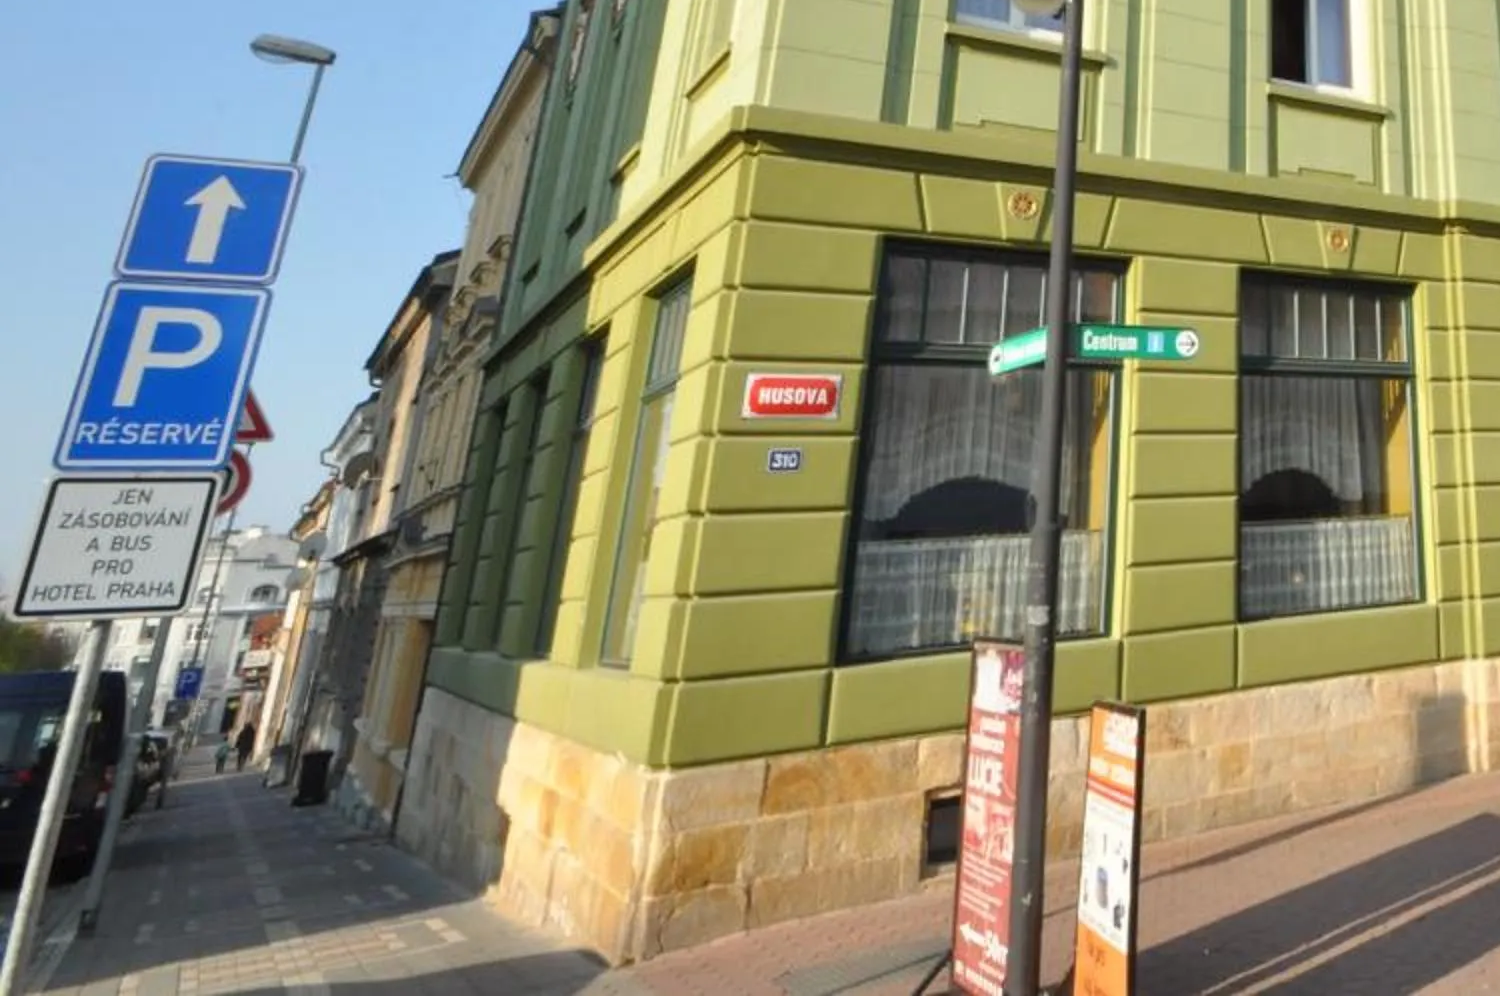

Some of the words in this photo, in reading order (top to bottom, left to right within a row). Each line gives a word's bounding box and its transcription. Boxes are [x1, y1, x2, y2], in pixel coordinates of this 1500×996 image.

[1083, 329, 1139, 351] Centrum
[112, 306, 223, 407] P
[758, 387, 828, 405] HUSOVA
[75, 416, 222, 445] RÉSERVÉ
[771, 452, 798, 469] 310
[112, 488, 154, 505] JEN
[57, 506, 191, 529] ZÁSOBOVÁNÍ
[86, 536, 100, 552] A
[110, 535, 152, 551] BUS
[91, 558, 133, 575] PRO
[32, 585, 97, 602] HOTEL
[107, 582, 176, 599] PRAHA
